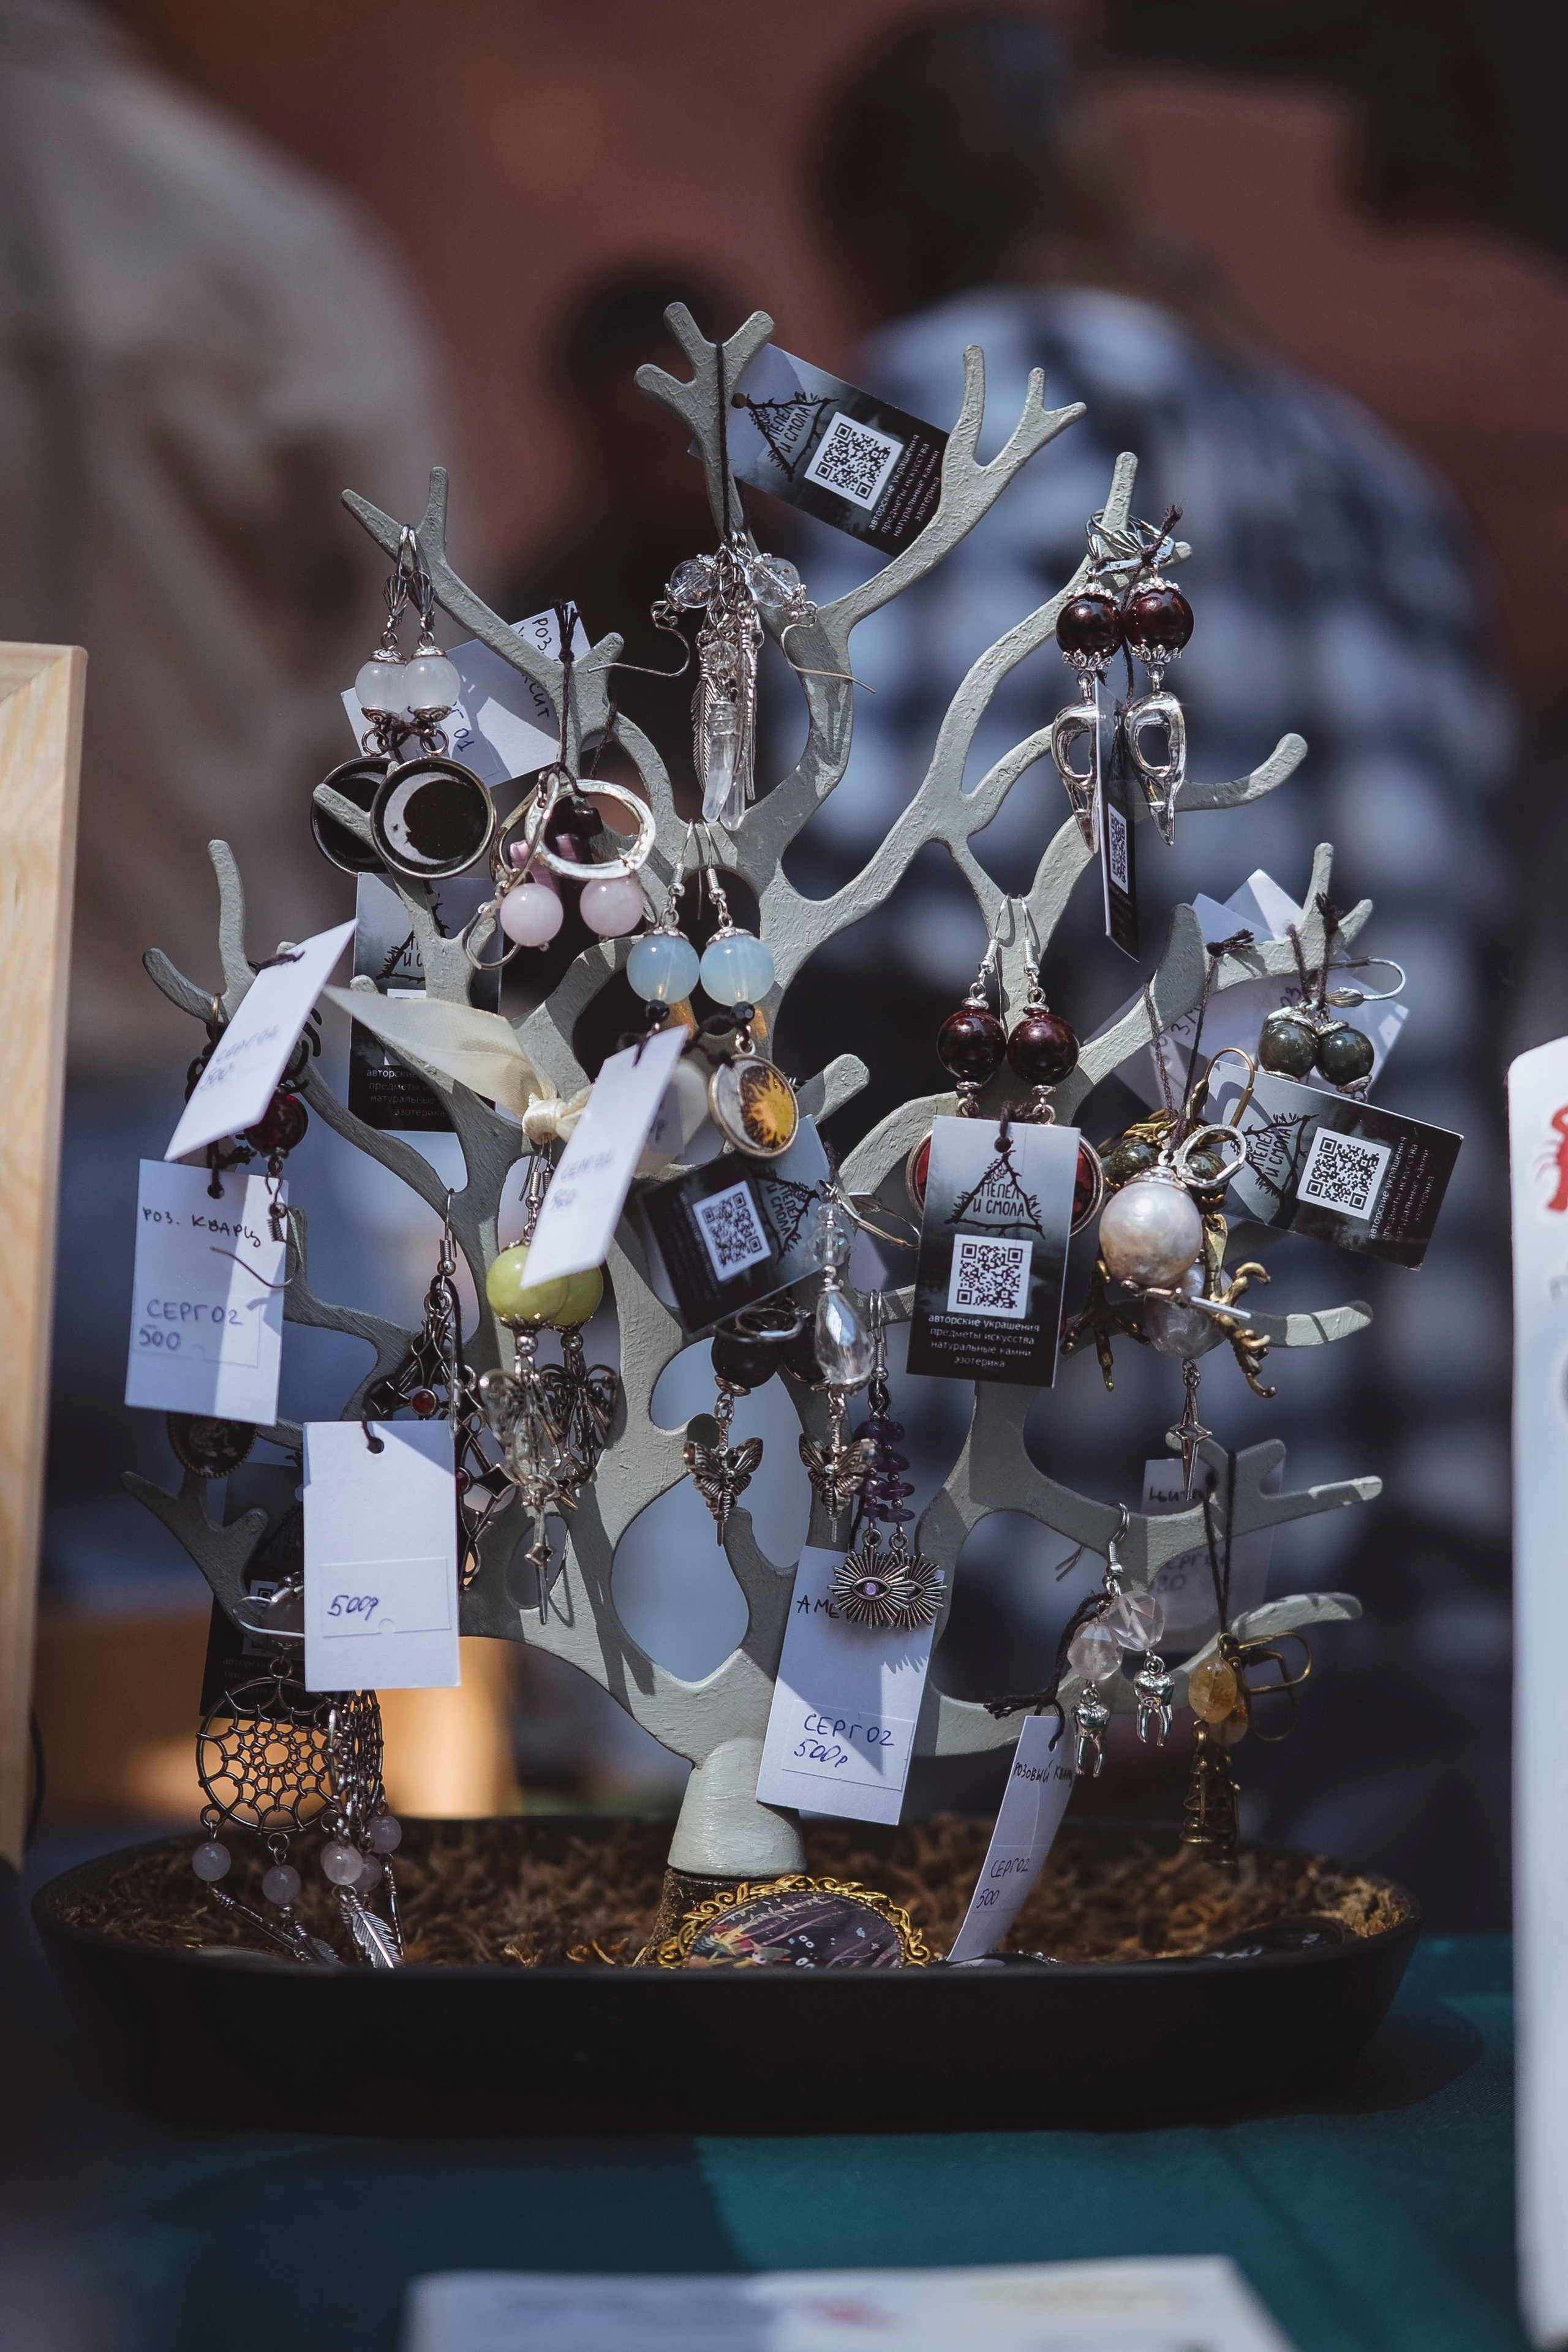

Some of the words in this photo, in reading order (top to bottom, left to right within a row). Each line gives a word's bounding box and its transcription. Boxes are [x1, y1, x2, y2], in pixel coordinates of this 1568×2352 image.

[767, 406, 794, 440] ПЕПЕЛ
[784, 407, 811, 442] СМОЛА
[778, 442, 793, 453] И
[869, 485, 895, 530] авторские
[892, 434, 920, 484] украшения
[881, 489, 908, 533] предметы
[904, 443, 930, 487] искусства
[893, 480, 925, 537] натуральные
[922, 450, 941, 478] камни
[914, 477, 941, 521] эзотерика
[371, 1095, 436, 1104] натуральные
[394, 1109, 445, 1119] эзотерика
[1251, 1130, 1275, 1166] ПЕПЕЛ
[1268, 1129, 1292, 1165] СМОЛА
[1265, 1167, 1280, 1177] И
[981, 1183, 1019, 1200] ПЕПЕЛ
[1369, 1191, 1389, 1239] авторские
[1385, 1136, 1408, 1189] украшения
[1382, 1193, 1402, 1240] предметы
[1399, 1144, 1418, 1190] искусства
[1415, 1176, 1434, 1223] эзотерика
[771, 1196, 791, 1235] СМОЛА
[973, 1199, 981, 1213] И
[986, 1200, 1024, 1216] СМОЛА
[929, 1314, 981, 1327] авторские
[983, 1320, 1040, 1332] украшения
[930, 1328, 981, 1339] предметы
[984, 1333, 1035, 1344] искусства
[138, 1324, 183, 1351] 500
[931, 1341, 997, 1353] натуральные
[1000, 1348, 1031, 1357] камни
[954, 1356, 1006, 1368] эзотерика
[1013, 1759, 1054, 1783] РОЗОВЫЙ
[976, 1888, 1000, 1909] 500
